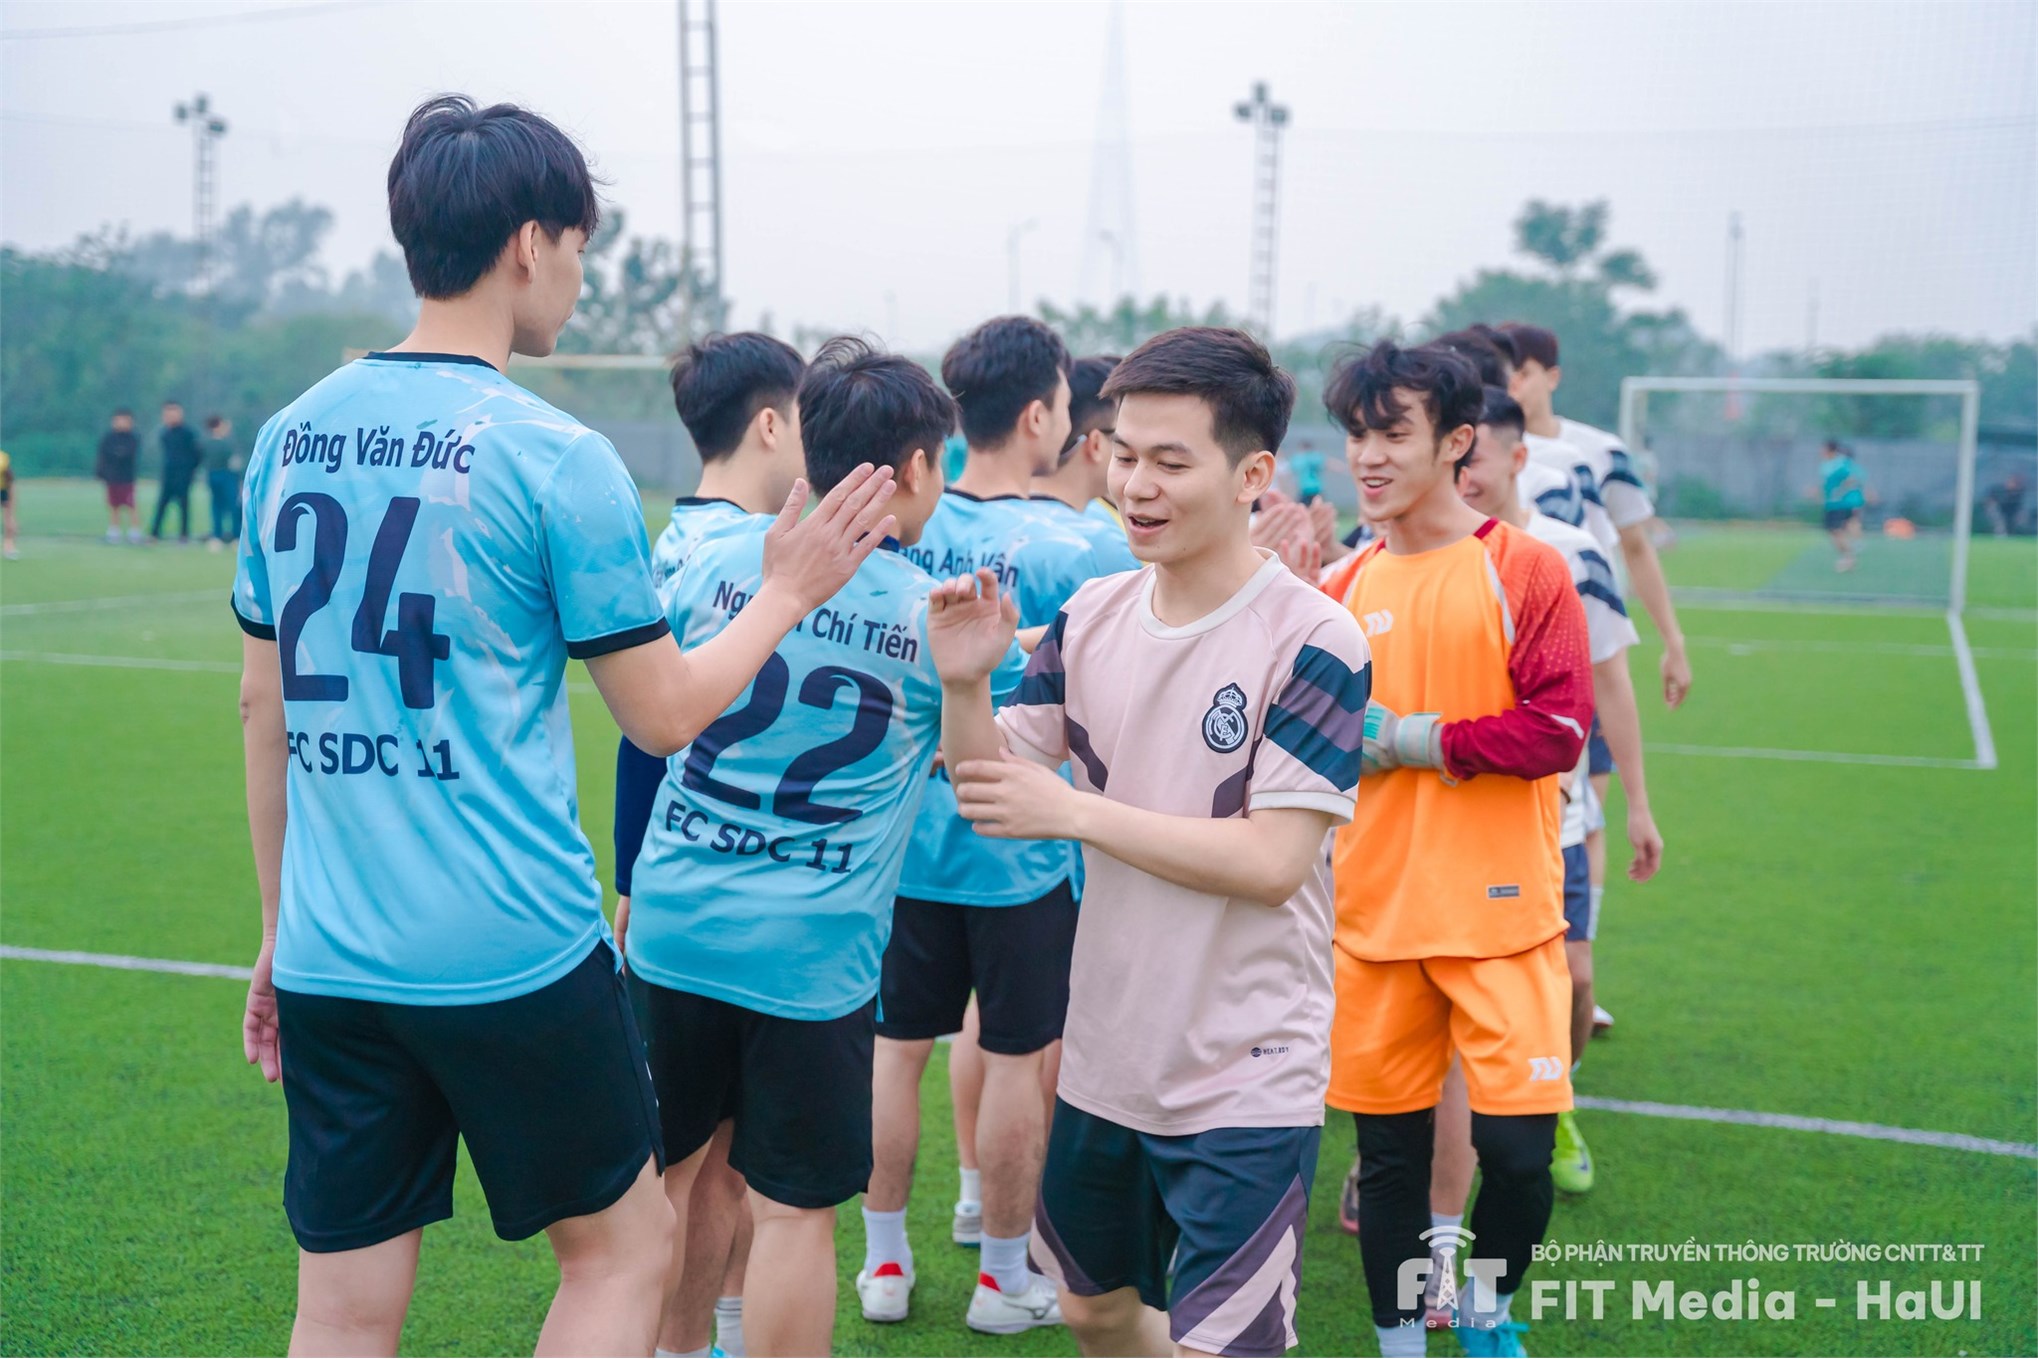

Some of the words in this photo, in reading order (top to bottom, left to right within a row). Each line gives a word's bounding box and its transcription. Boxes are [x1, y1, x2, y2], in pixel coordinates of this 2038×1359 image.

[281, 421, 347, 474] Đồng
[356, 425, 405, 468] Văn
[410, 428, 476, 474] Đức
[938, 547, 975, 574] Anh
[980, 551, 1020, 588] Vân
[274, 491, 451, 710] 24
[812, 607, 858, 646] Chí
[862, 619, 919, 663] Tiến
[318, 731, 400, 777] SDC
[415, 738, 461, 781] 11
[681, 650, 894, 826] 22
[665, 799, 709, 842] FC
[709, 822, 797, 862] SDC
[805, 837, 854, 874] 11
